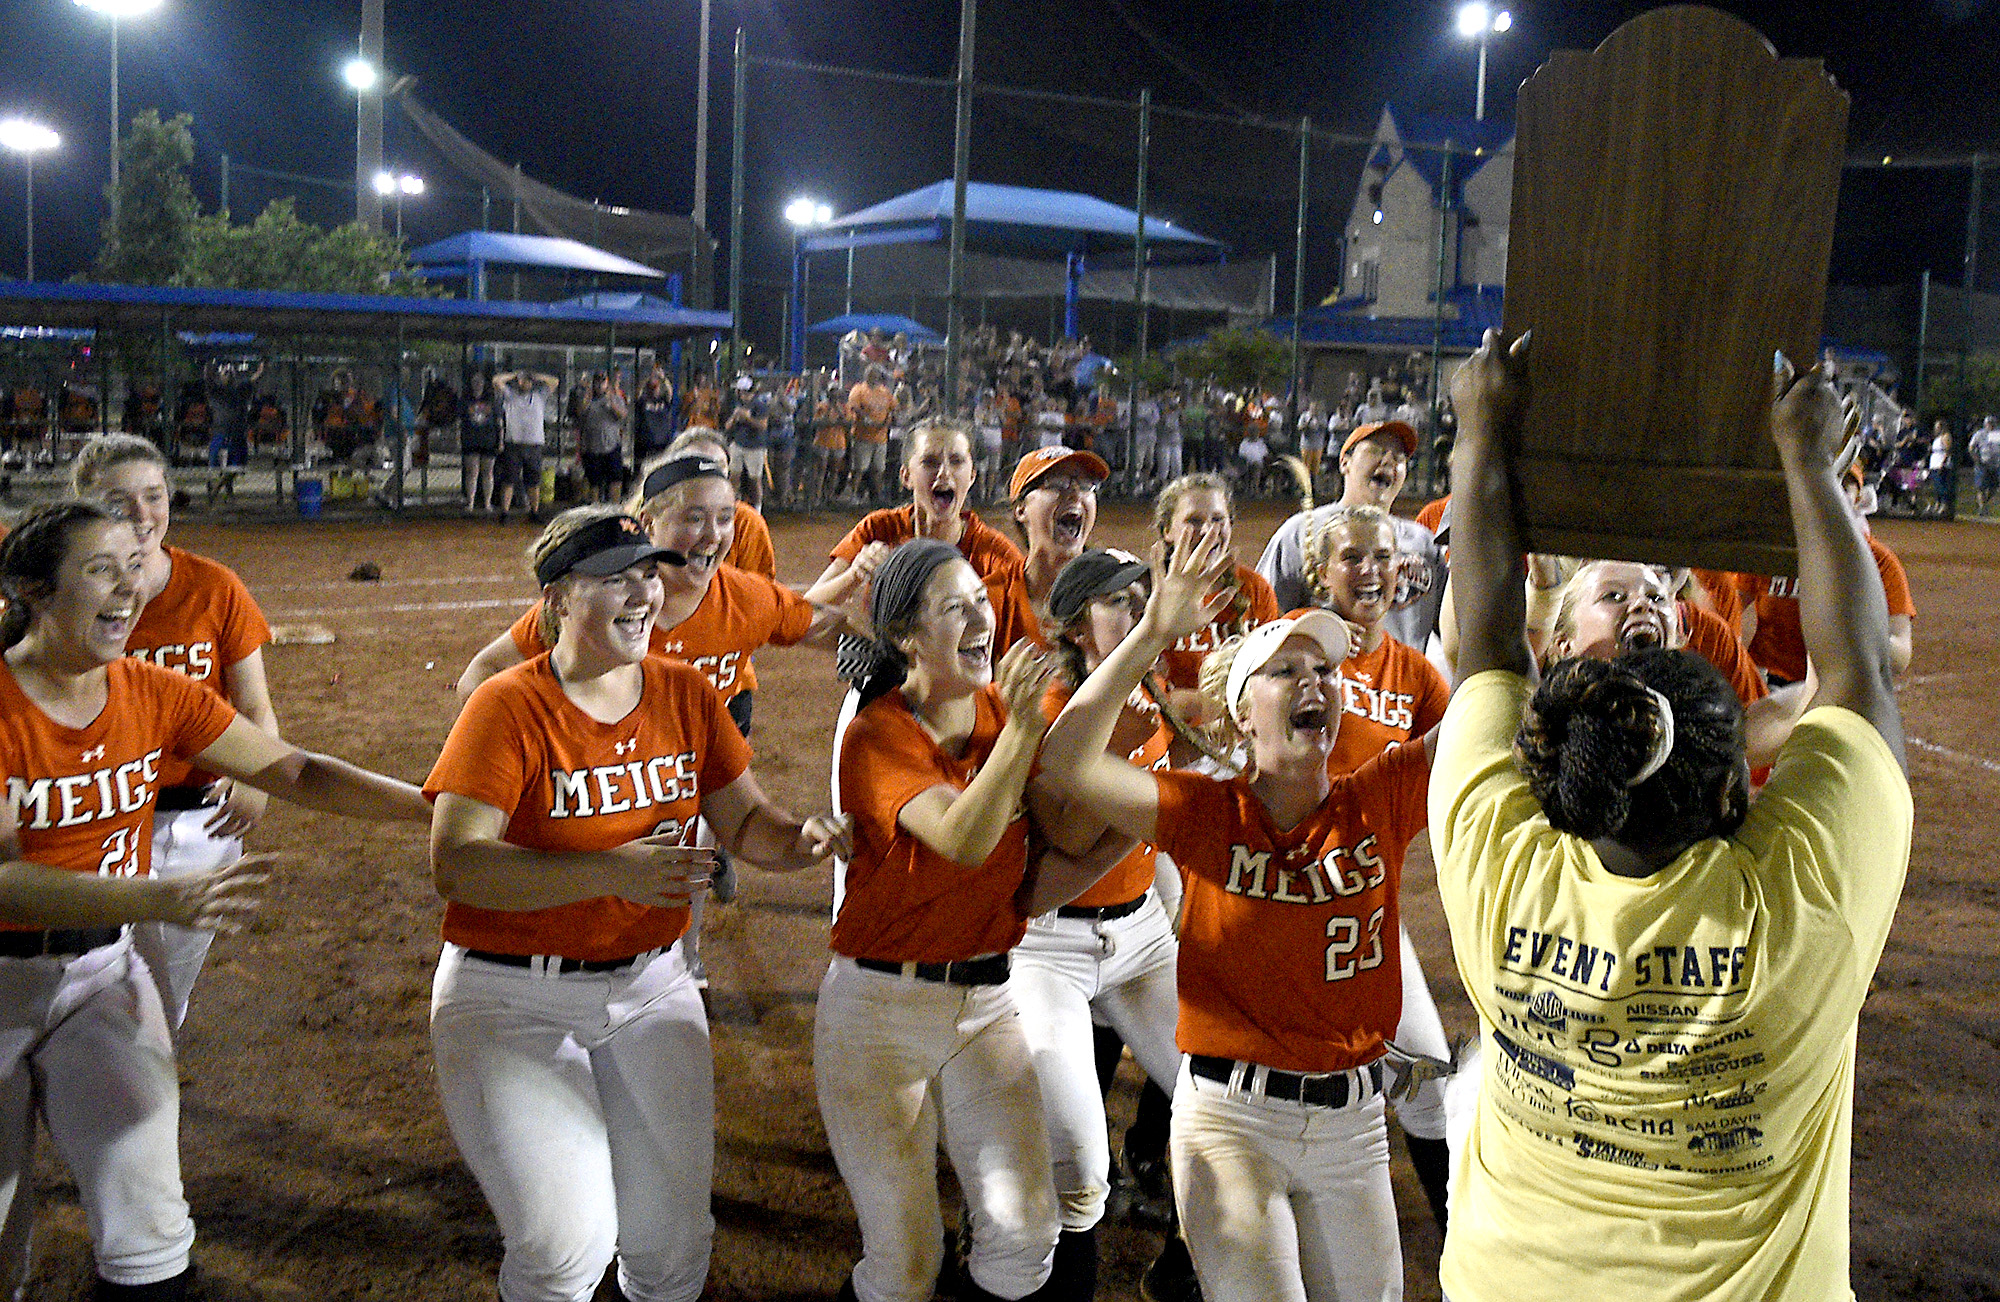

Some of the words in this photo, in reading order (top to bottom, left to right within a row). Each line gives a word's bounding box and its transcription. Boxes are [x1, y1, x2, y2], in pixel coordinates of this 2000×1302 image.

[550, 751, 698, 819] MEIGS
[1225, 834, 1386, 905] MEIGS
[1325, 906, 1385, 983] 23
[1503, 925, 1617, 992] EVENT
[1634, 945, 1748, 988] STAFF
[1626, 1003, 1699, 1017] NISSAN
[1646, 1041, 1690, 1056] DELTA
[1692, 1028, 1755, 1055] DENTAL
